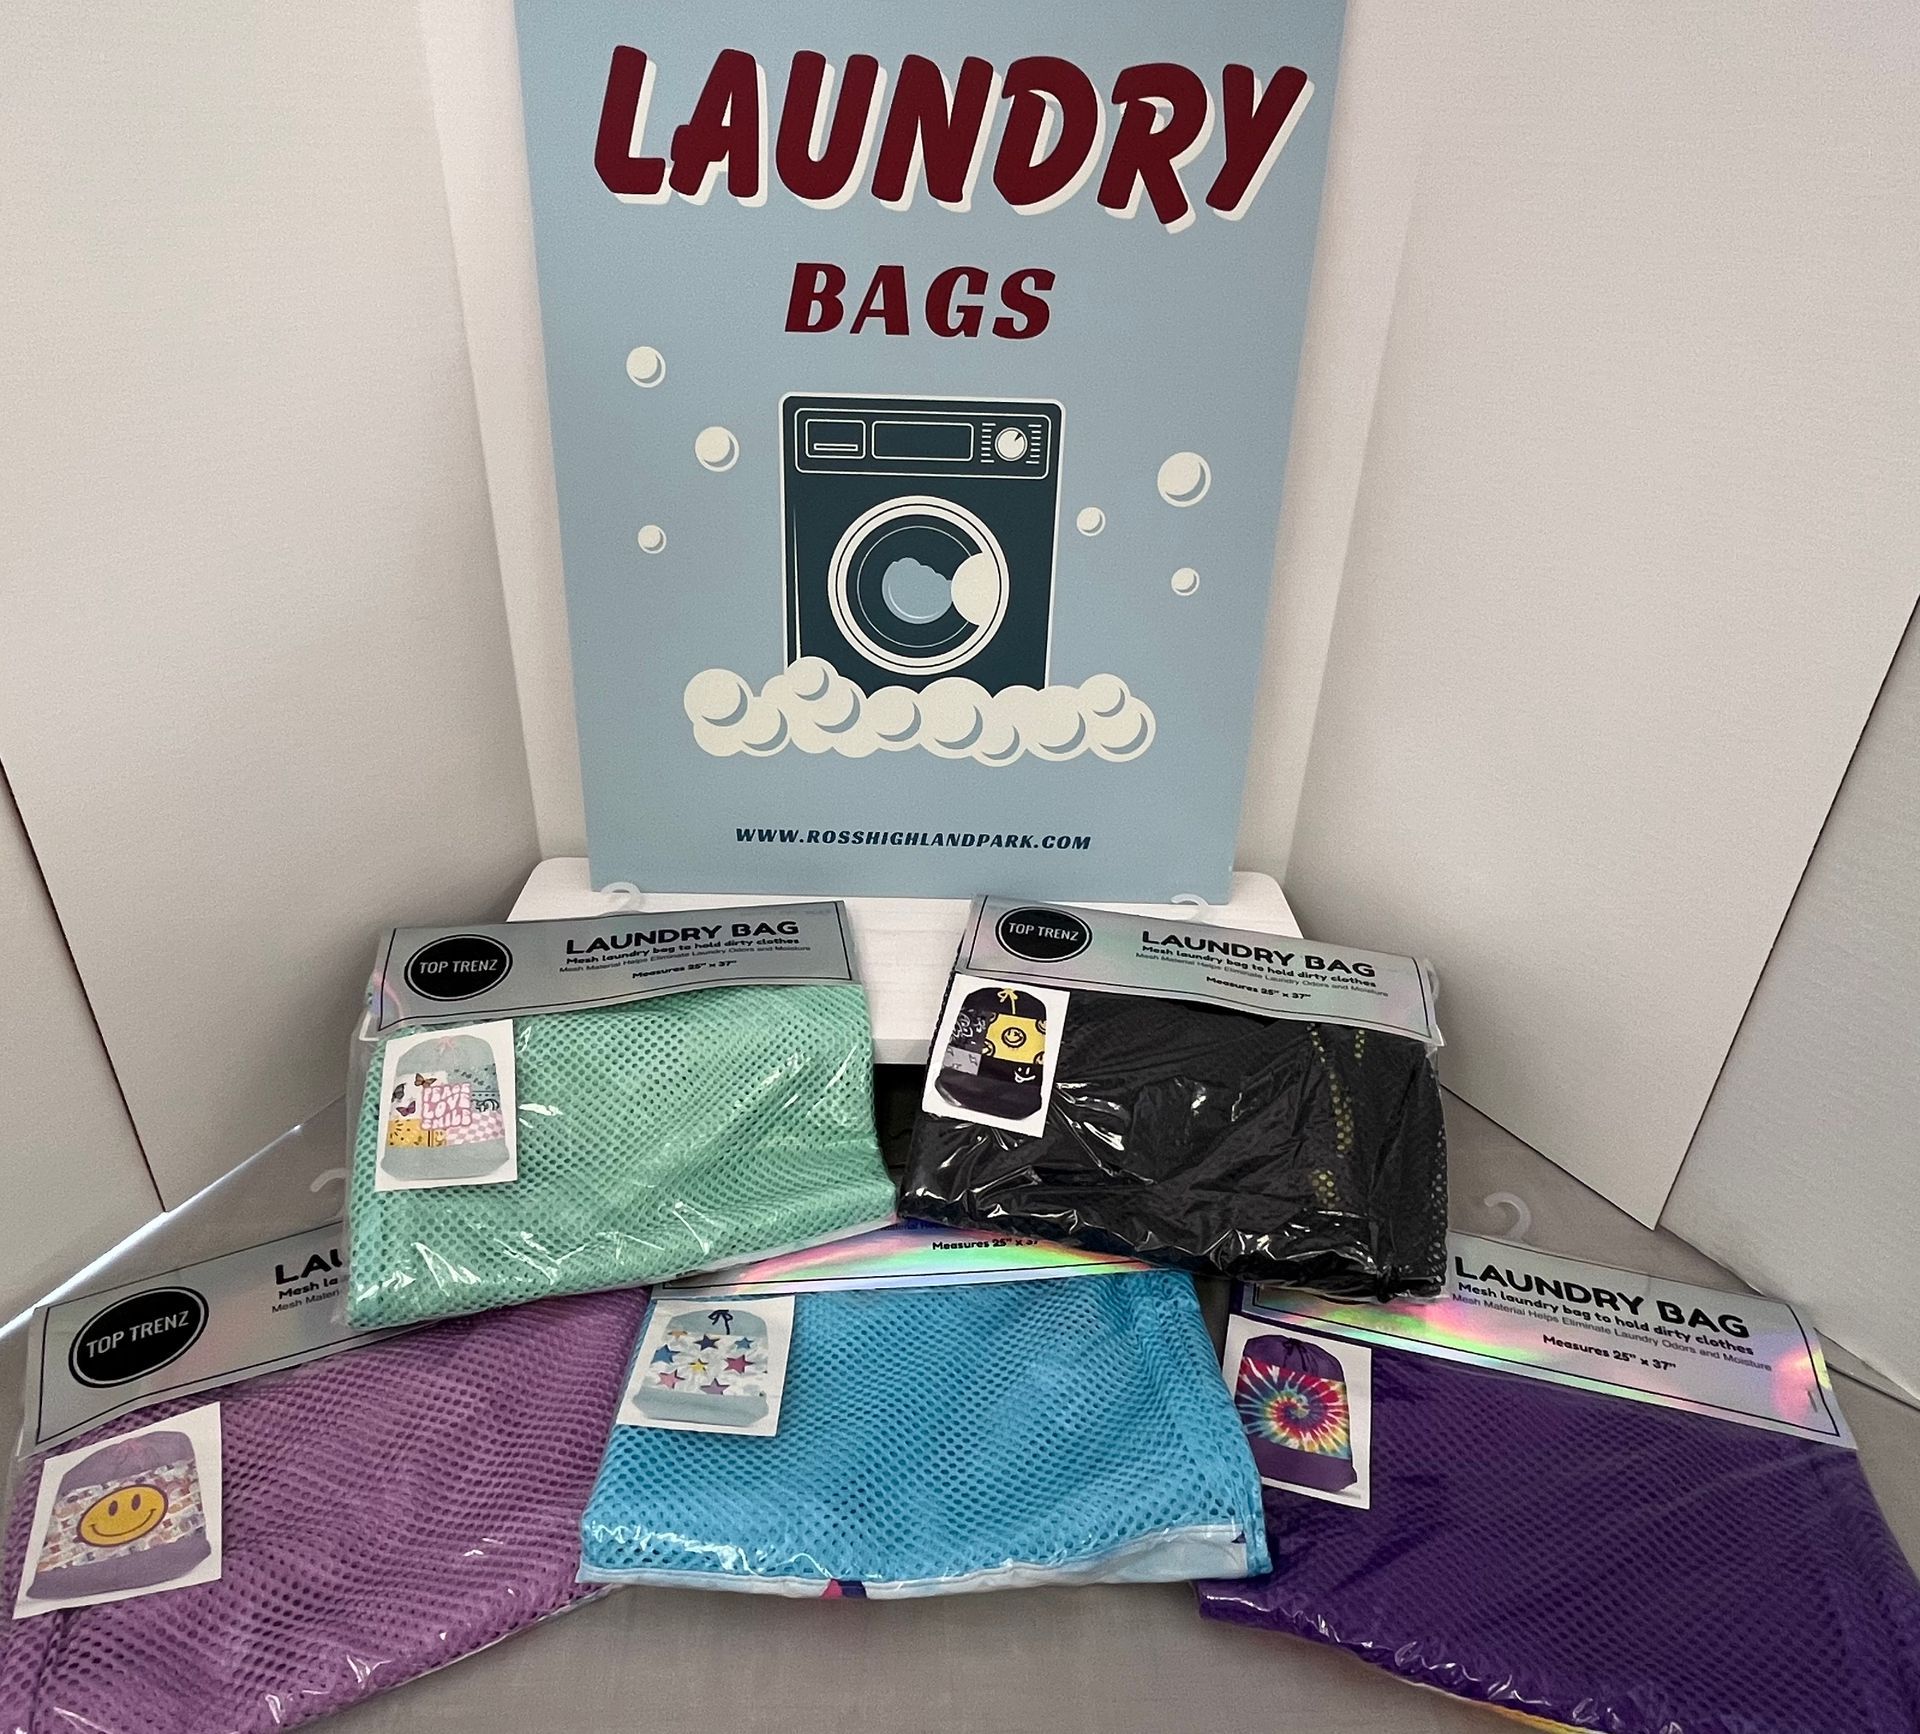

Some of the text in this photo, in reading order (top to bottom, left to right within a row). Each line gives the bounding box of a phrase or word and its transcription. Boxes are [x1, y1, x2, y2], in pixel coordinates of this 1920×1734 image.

[594, 45, 1314, 233] LAUNDRY
[785, 262, 1057, 340] BAGS
[735, 828, 1091, 850] WWW.ROSSHIGHLANDPARK.COM
[566, 921, 799, 954] LAUNDRY BAG
[1009, 922, 1079, 941] TOP TRENZ
[566, 956, 599, 964] Mesh
[602, 950, 650, 961] laundry
[653, 947, 675, 955] bag
[695, 941, 721, 949] hold
[1142, 931, 1376, 977] LAUNDRY BAG
[420, 959, 498, 974] TOP TRENZ
[632, 966, 685, 978] Measures
[1142, 946, 1376, 987] Mesh laundry bag to hold dirty clothes
[1206, 976, 1258, 992] Measures
[423, 1092, 471, 1119] LOVE
[421, 1109, 471, 1130] SMILE
[932, 1241, 990, 1250] Measures
[992, 1238, 1012, 1247] 25"
[1015, 1239, 1023, 1247] x
[279, 1282, 319, 1299] Mesh
[1455, 1256, 1750, 1338] LAUNDRY BAG
[272, 1300, 302, 1313] Mesh
[1458, 1282, 1754, 1355] Mesh laundry bag to hold dirty clothes
[86, 1310, 189, 1358] TOP TRENZ
[1452, 1293, 1772, 1371] Mesh Material Helps Eliminate Laundry Odors and Moisture
[1543, 1334, 1676, 1370] Measures 25" x 37"
